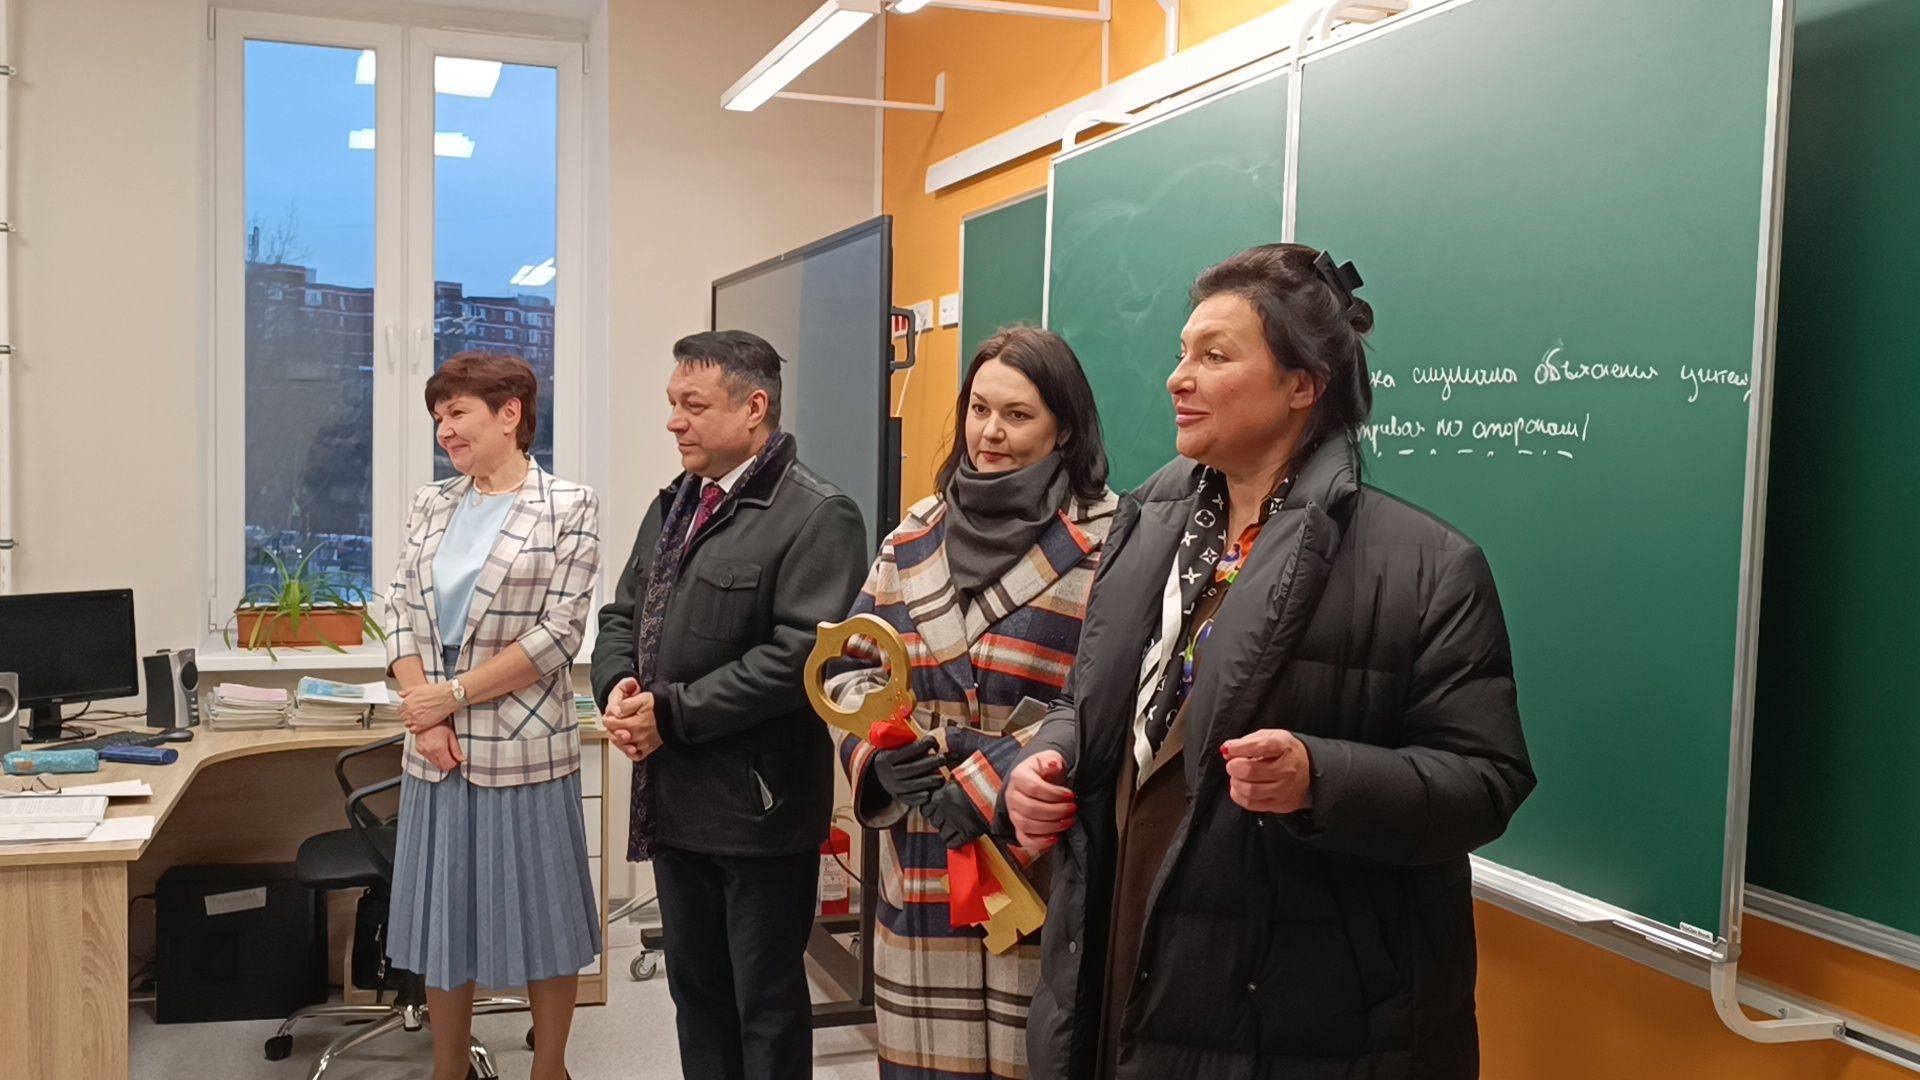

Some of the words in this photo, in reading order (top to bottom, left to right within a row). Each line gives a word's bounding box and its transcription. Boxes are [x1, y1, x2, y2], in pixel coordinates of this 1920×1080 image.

[1369, 369, 1396, 389] ка
[1412, 365, 1518, 402] слушала
[1436, 418, 1464, 438] по
